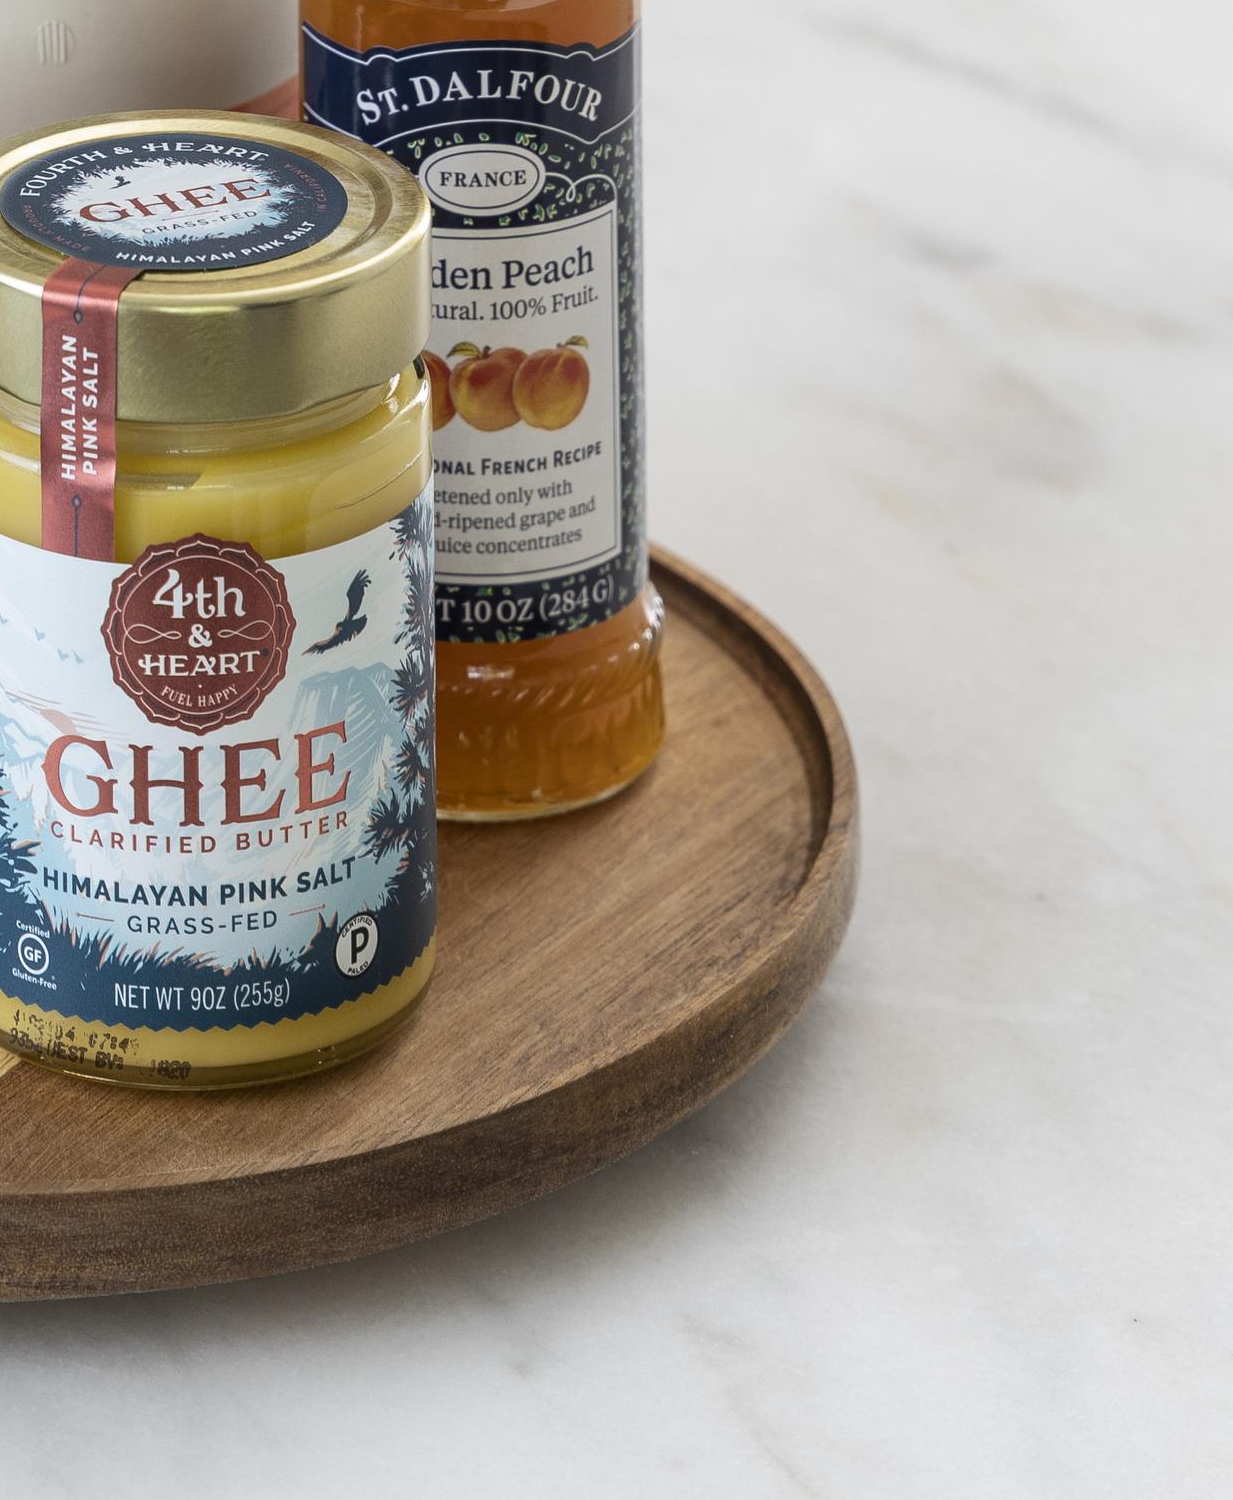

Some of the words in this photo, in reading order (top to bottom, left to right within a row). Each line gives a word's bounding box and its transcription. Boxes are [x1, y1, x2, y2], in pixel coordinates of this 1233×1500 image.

[356, 88, 410, 125] ST.
[410, 68, 603, 122] DALFOUR
[20, 150, 109, 197] FOURTH
[114, 146, 133, 155] &
[142, 142, 270, 162] HEART
[439, 169, 526, 188] FRANCE
[79, 178, 272, 223] GHEE
[142, 211, 258, 235] GRASS-FED
[116, 251, 237, 264] HIMALAYAN
[241, 239, 285, 256] PINK
[284, 221, 316, 241] SALT
[502, 245, 595, 289] Peach
[490, 295, 547, 320] 100%
[551, 285, 599, 313] Fruit.
[82, 348, 99, 409] SALT
[61, 335, 78, 481] HIMALAYAN
[82, 411, 99, 477] PINK
[481, 456, 547, 476] FRENCH
[553, 440, 602, 468] RECIPE
[495, 486, 534, 506] only
[537, 479, 573, 501] with
[520, 508, 565, 531] grape
[568, 495, 598, 519] and
[475, 527, 583, 555] concentrates
[152, 568, 246, 619] 4th
[462, 599, 492, 623] 10
[496, 598, 535, 622] OZ
[188, 623, 213, 648] &
[138, 650, 261, 677] HEART
[161, 685, 192, 708] FUEL
[198, 684, 239, 708] HAPPY
[41, 720, 351, 827] GHEE
[50, 820, 216, 854] CLARIFIED
[237, 810, 348, 851] BUTTER
[42, 866, 208, 907] HIMALAYAN
[220, 876, 286, 906] PINK
[295, 855, 356, 893] SALT
[16, 919, 51, 939] Certified
[127, 910, 278, 934] GRASS-FED
[341, 916, 373, 939] CERTIFIED
[24, 946, 42, 963] GF
[351, 926, 369, 965] P
[12, 967, 57, 991] Gluten-Free
[346, 960, 369, 975] PALEO
[114, 983, 150, 1009] NET
[155, 987, 184, 1011] WT
[233, 983, 291, 1011] (255g)
